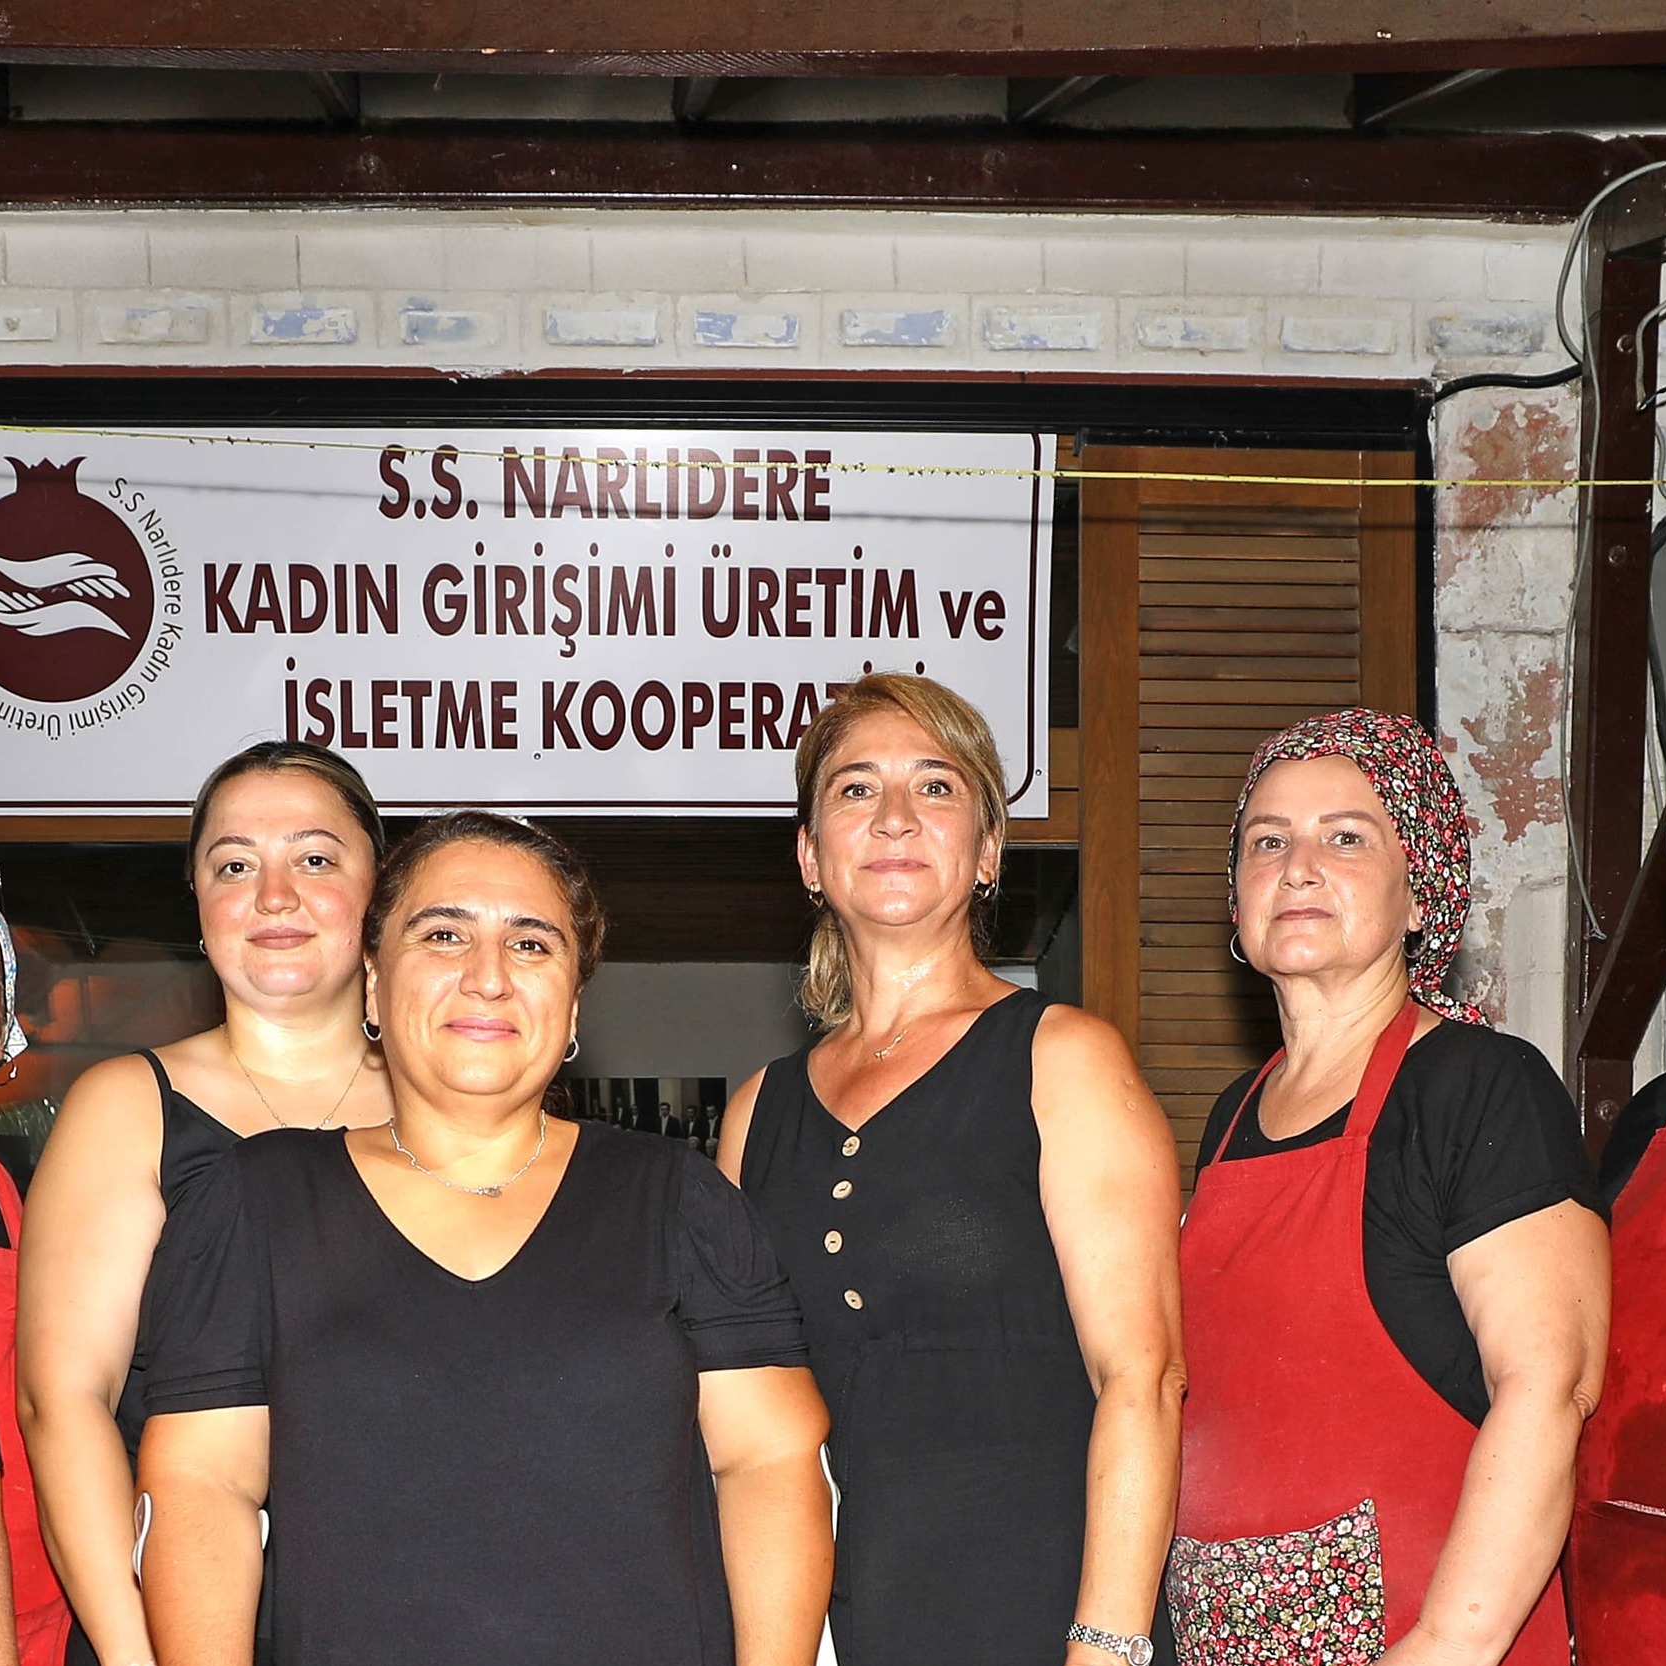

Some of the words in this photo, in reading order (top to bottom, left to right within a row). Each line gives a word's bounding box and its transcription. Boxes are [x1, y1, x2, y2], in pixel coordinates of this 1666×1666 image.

[108, 477, 145, 512] S.S
[377, 444, 481, 520] S.S.
[503, 446, 832, 522] NARLIDERE
[138, 508, 184, 616] Narlıdere
[203, 563, 398, 634] KADIN
[423, 541, 676, 658] GİRİŞİMİ
[702, 544, 921, 639] ÜRETİM
[940, 588, 1007, 641] ve
[141, 621, 183, 684] Kadın
[68, 683, 146, 736] Girişimi
